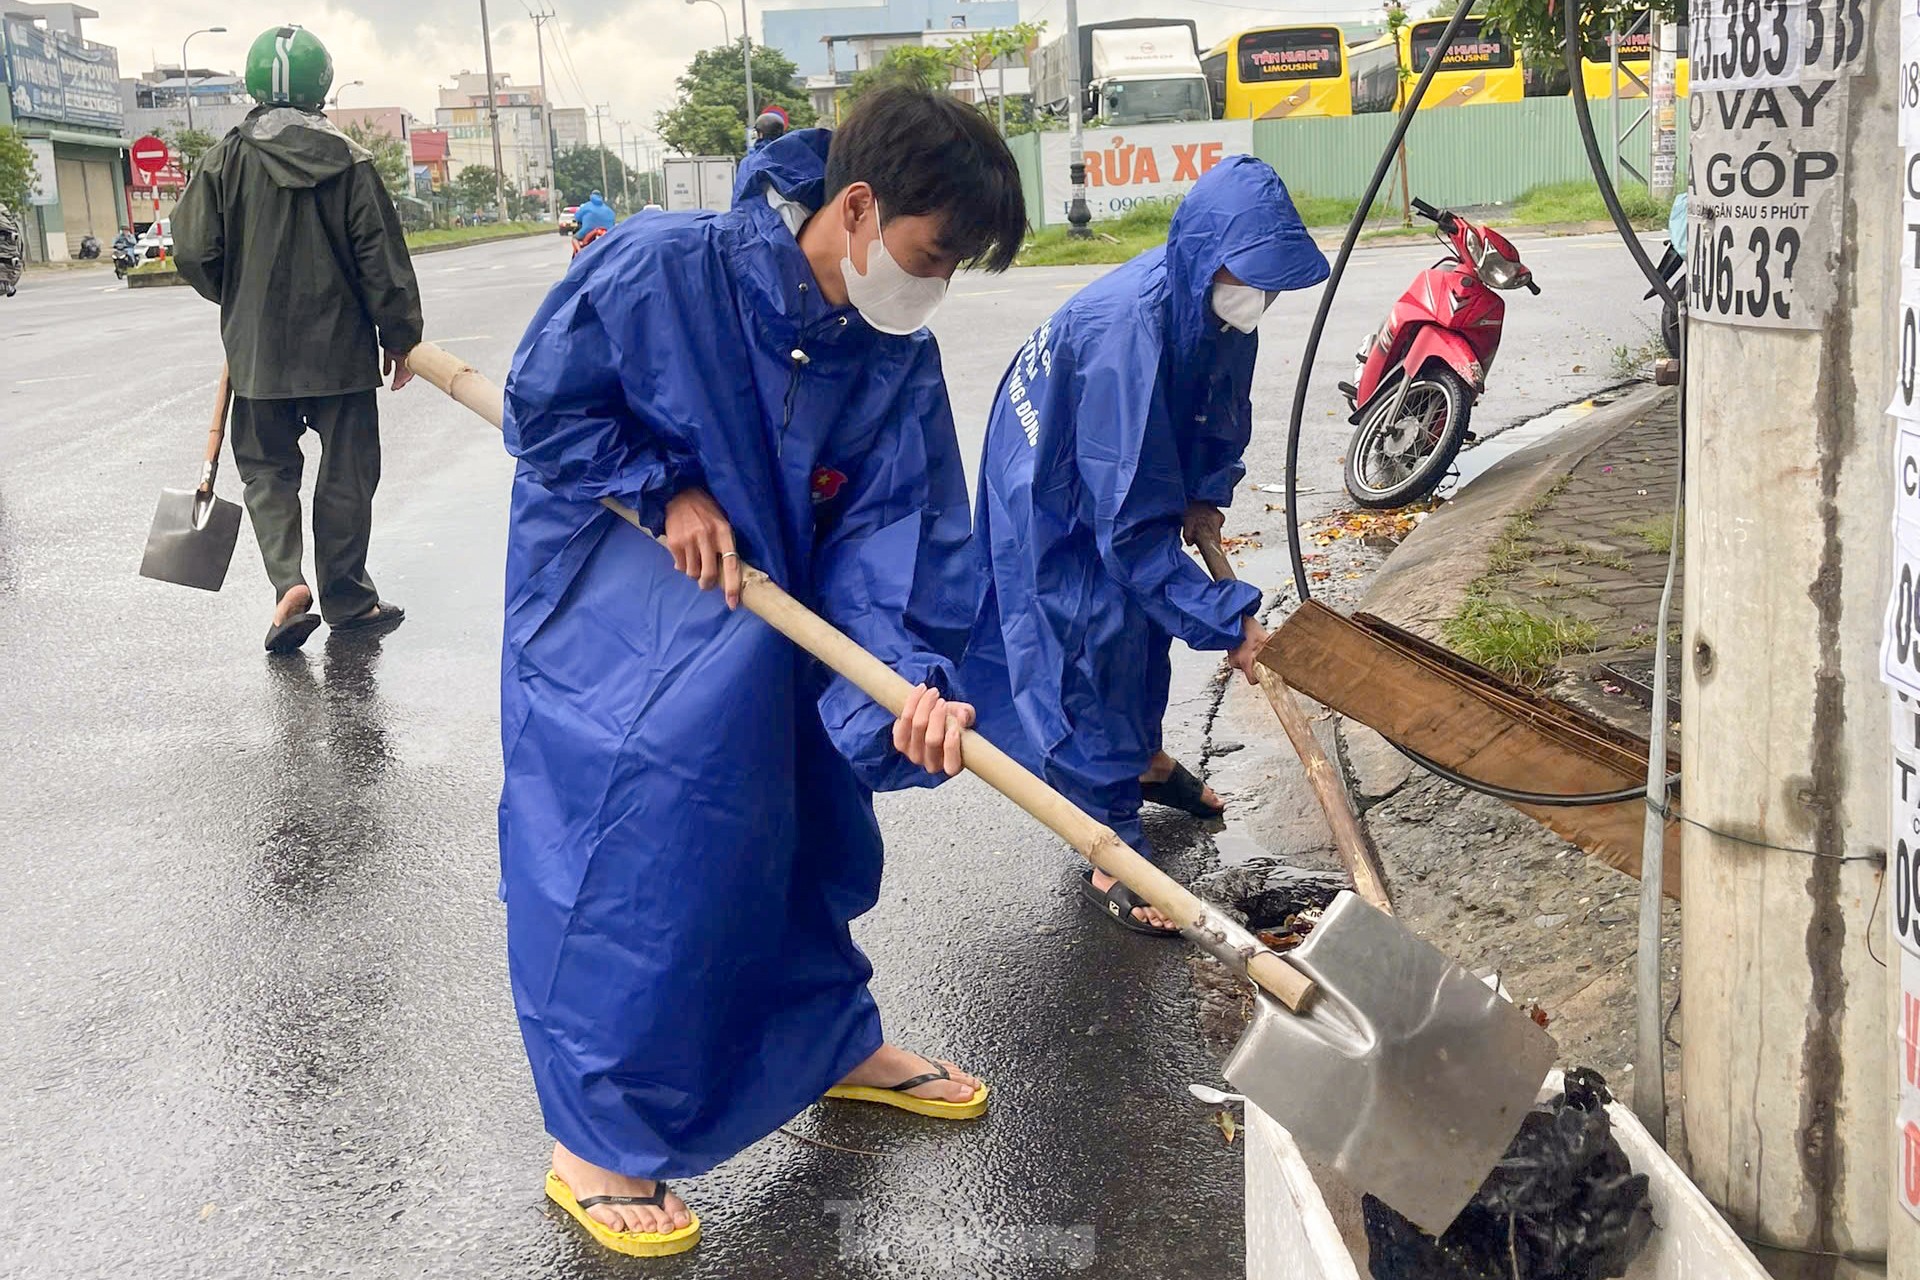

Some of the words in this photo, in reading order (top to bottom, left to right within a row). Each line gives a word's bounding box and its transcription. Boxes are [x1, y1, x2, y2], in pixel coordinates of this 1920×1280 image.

[1263, 62, 1319, 73] LIMOUSINE
[1440, 53, 1489, 64] IMOUSINE
[1717, 79, 1838, 130] VAY
[1082, 135, 1160, 188] RỬA
[1172, 142, 1224, 182] XE
[1706, 140, 1839, 198] GÓP
[1708, 202, 1733, 218] GÂN
[1735, 205, 1758, 219] SAU
[1760, 205, 1768, 219] 5
[1771, 202, 1810, 219] PHÚT
[1689, 223, 1801, 320] 406.33
